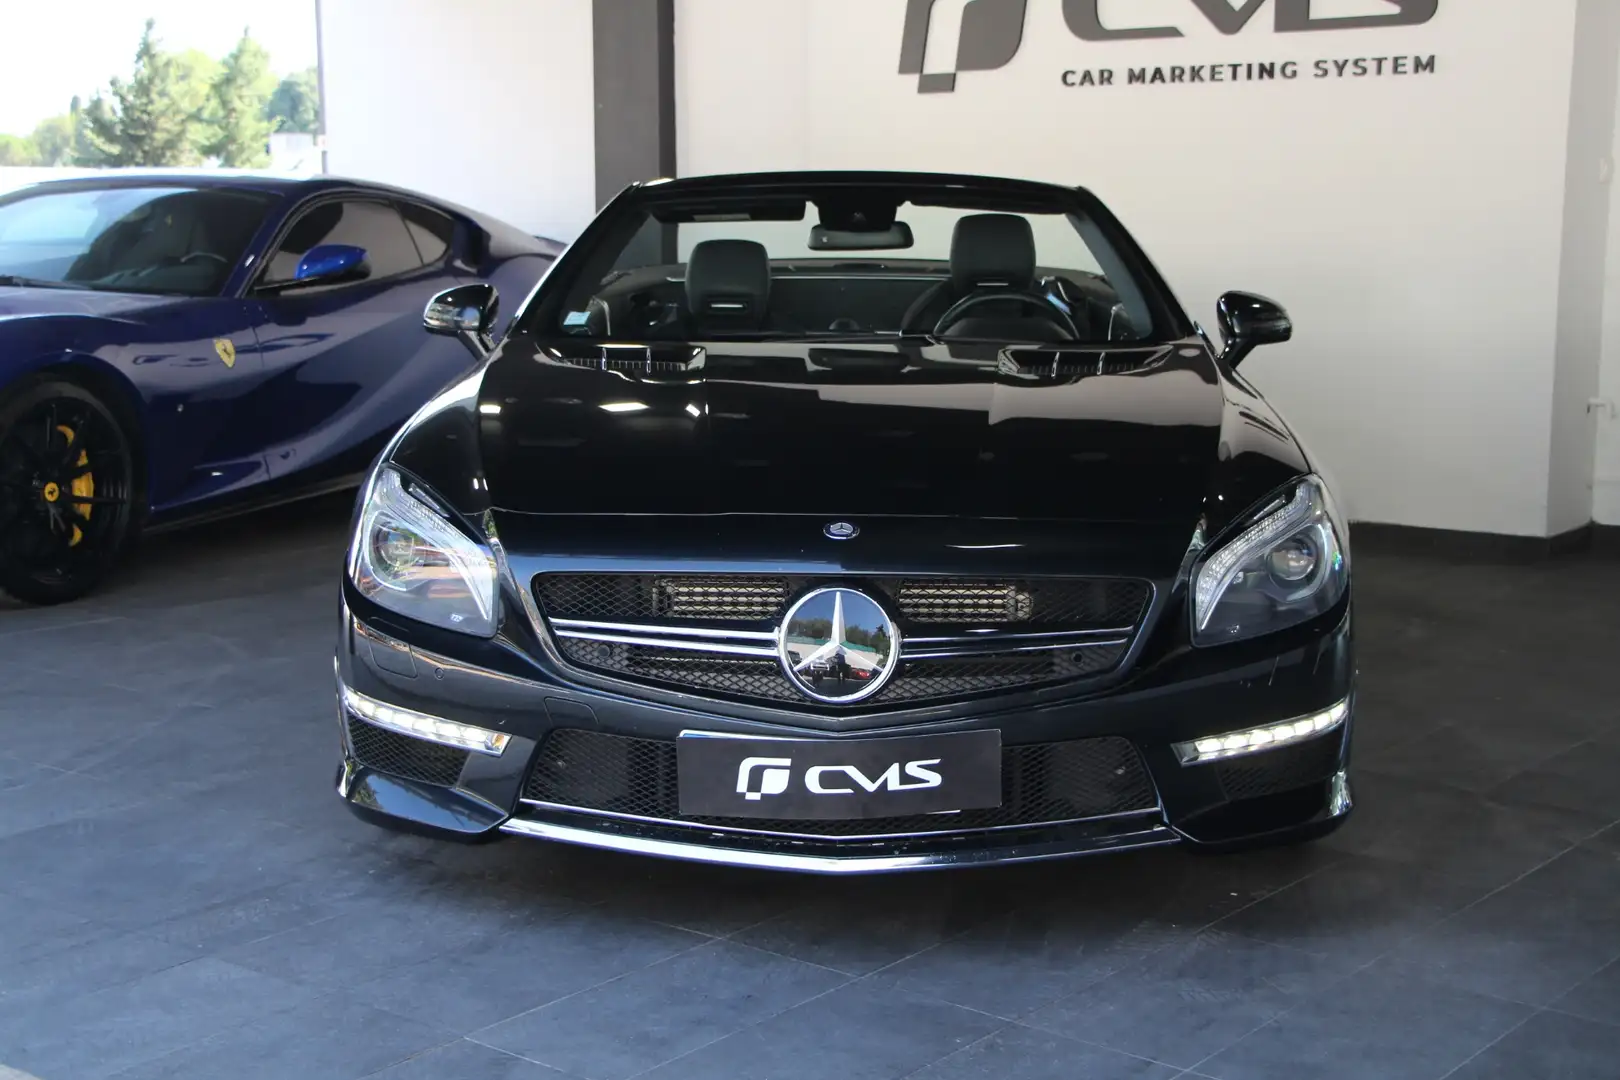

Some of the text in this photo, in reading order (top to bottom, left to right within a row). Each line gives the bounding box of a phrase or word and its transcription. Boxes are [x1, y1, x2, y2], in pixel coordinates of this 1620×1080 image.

[1062, 55, 1435, 87] CAR MARKETING SYSTEM
[805, 759, 941, 793] CMS
